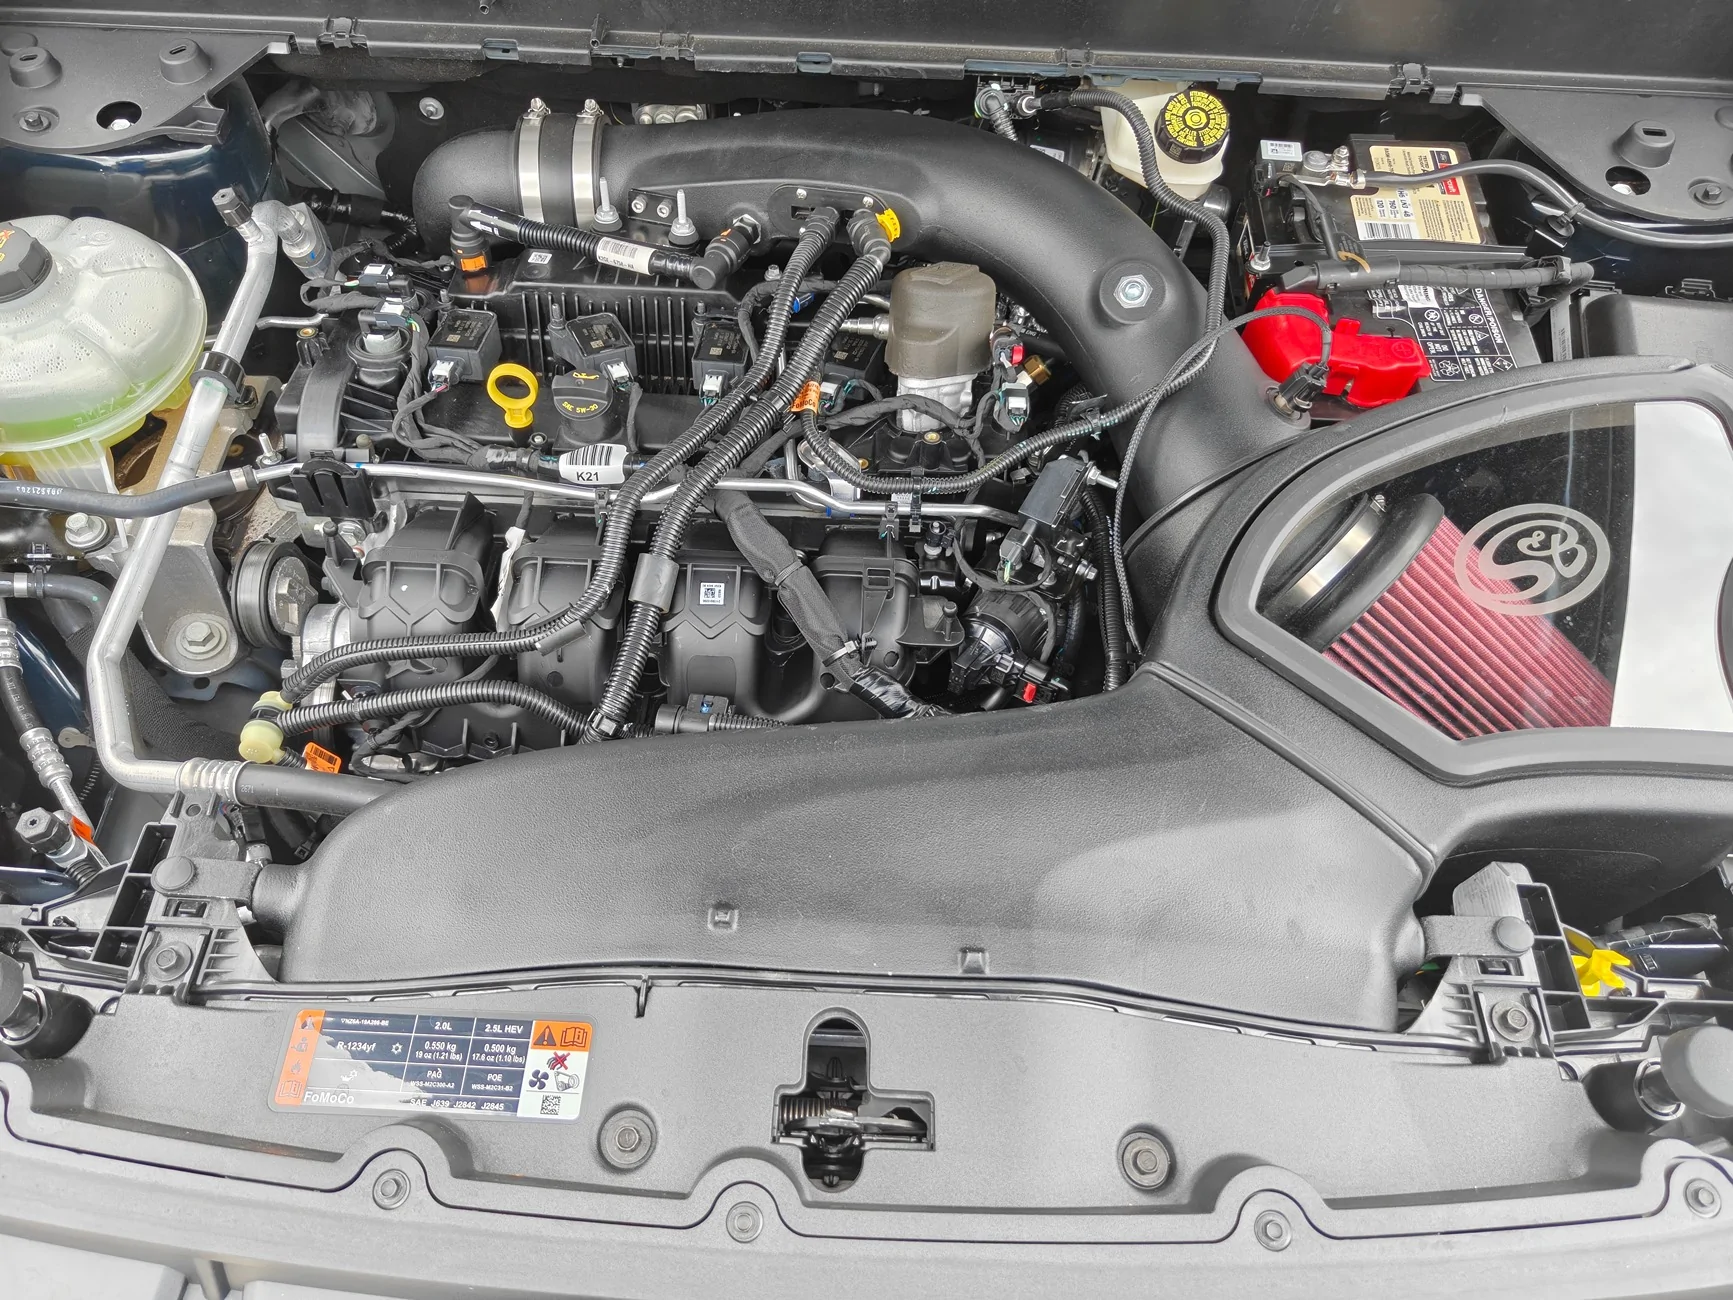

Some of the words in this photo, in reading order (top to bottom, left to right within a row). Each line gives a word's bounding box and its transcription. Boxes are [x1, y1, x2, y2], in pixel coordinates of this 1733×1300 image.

[1474, 288, 1504, 343] DANGER/POISON
[562, 401, 574, 411] SAE
[576, 403, 598, 413] 5W-30
[576, 471, 599, 481] K21
[1478, 519, 1588, 599] S&B
[434, 1021, 453, 1030] 2.0L
[485, 1024, 503, 1033] 2.5L
[504, 1025, 524, 1034] HEV
[336, 1041, 377, 1053] R-1234yf
[425, 1041, 444, 1050] 0.550
[446, 1042, 457, 1052] kg
[484, 1043, 505, 1053] 0.500
[506, 1045, 517, 1054] kg
[433, 1052, 448, 1061] (1.21
[450, 1052, 463, 1061] lbs)
[496, 1053, 511, 1063] (1.10
[513, 1054, 526, 1064] lbs)
[427, 1070, 442, 1079] PAG
[487, 1073, 503, 1081] POE
[303, 1091, 355, 1104] FoMoCo
[409, 1098, 428, 1107] SAE
[453, 1101, 476, 1109] J2842
[481, 1101, 504, 1110] J2845
